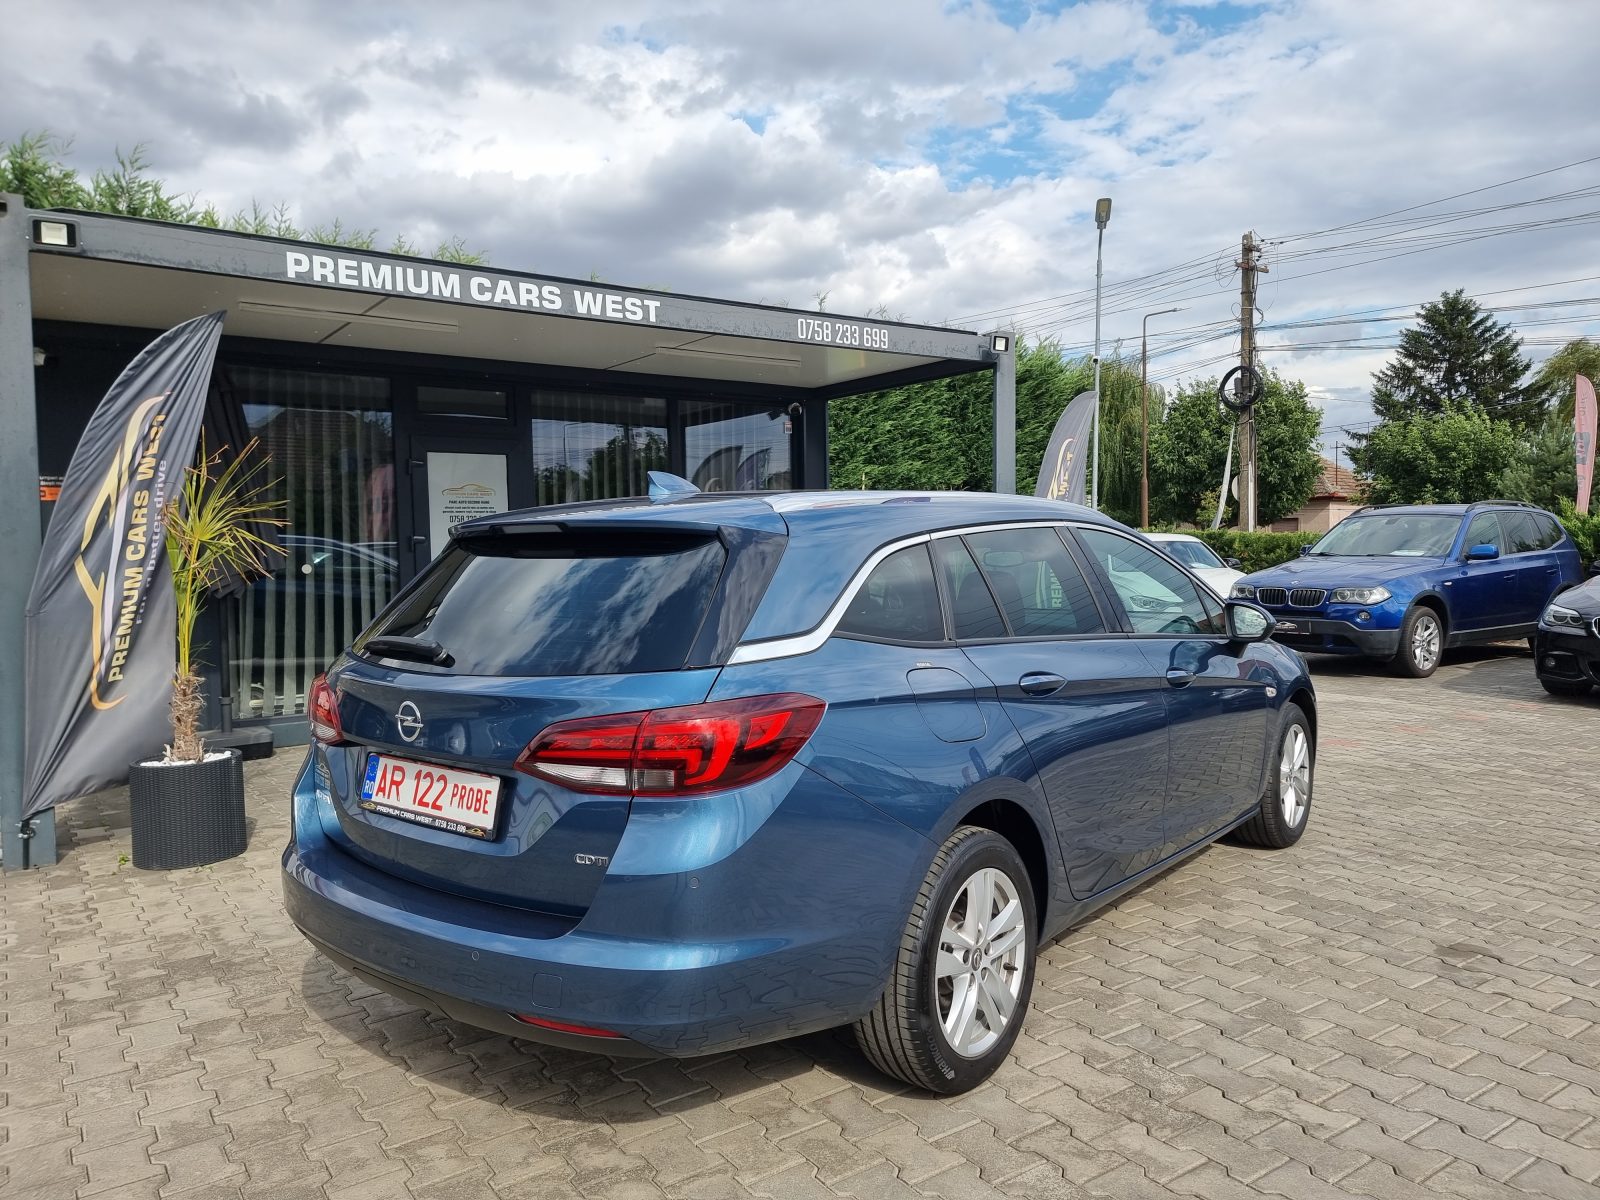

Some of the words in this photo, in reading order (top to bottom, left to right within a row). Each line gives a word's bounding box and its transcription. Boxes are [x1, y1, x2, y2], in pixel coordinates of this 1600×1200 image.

[285, 251, 461, 299] PREMIUM
[469, 276, 562, 310] CARS
[573, 289, 661, 322] WEST
[797, 318, 832, 342] 0758
[835, 323, 859, 345] 233
[863, 327, 888, 349] 699
[136, 414, 166, 481] WEST
[153, 459, 167, 508] drive
[126, 489, 150, 561] CARS
[108, 566, 144, 683] PREMIUM
[364, 780, 374, 794] RO
[375, 763, 406, 801] AR
[412, 769, 448, 812] 122
[450, 783, 492, 815] PROBE
[376, 805, 400, 816] PREMIUM
[400, 810, 415, 820] CARS
[415, 815, 433, 824] WEST
